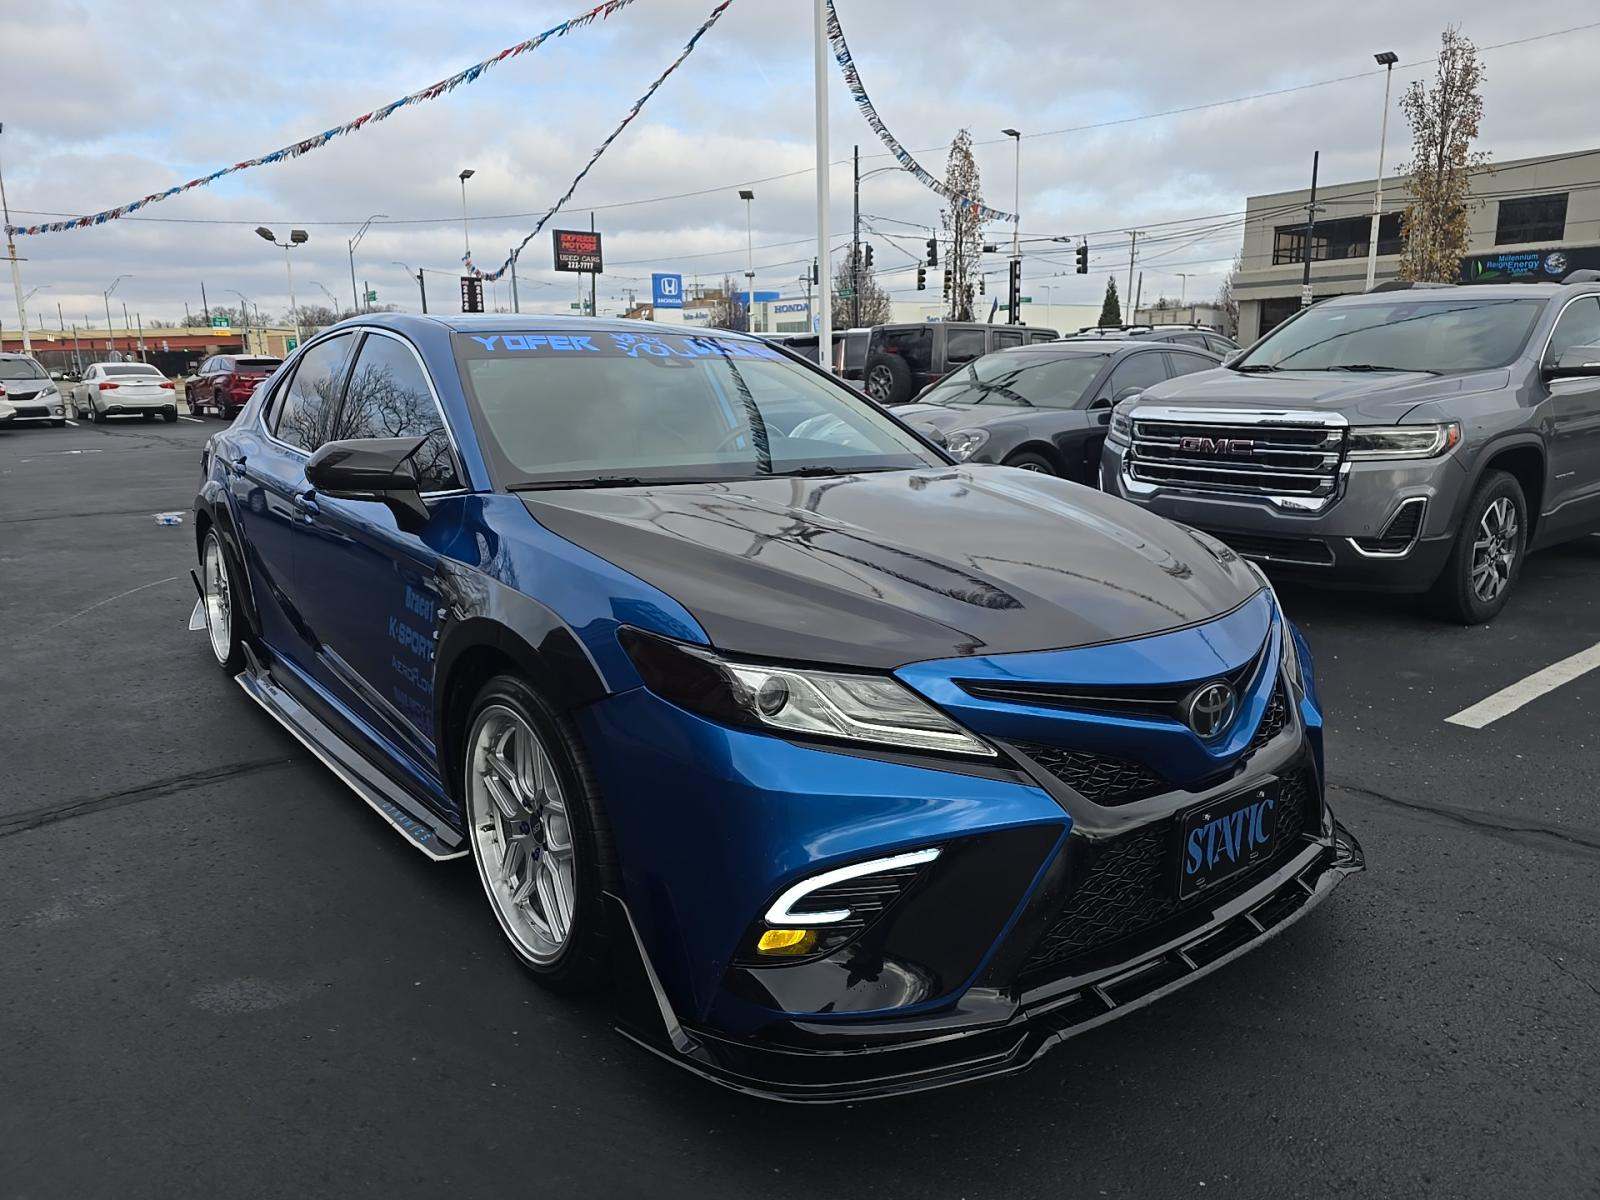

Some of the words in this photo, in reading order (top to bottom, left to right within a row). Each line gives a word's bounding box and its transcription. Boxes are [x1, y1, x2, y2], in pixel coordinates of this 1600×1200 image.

[774, 303, 809, 314] HONDA
[470, 335, 601, 351] YOFER
[1180, 436, 1255, 455] GMC
[1186, 799, 1275, 875] STATIC
